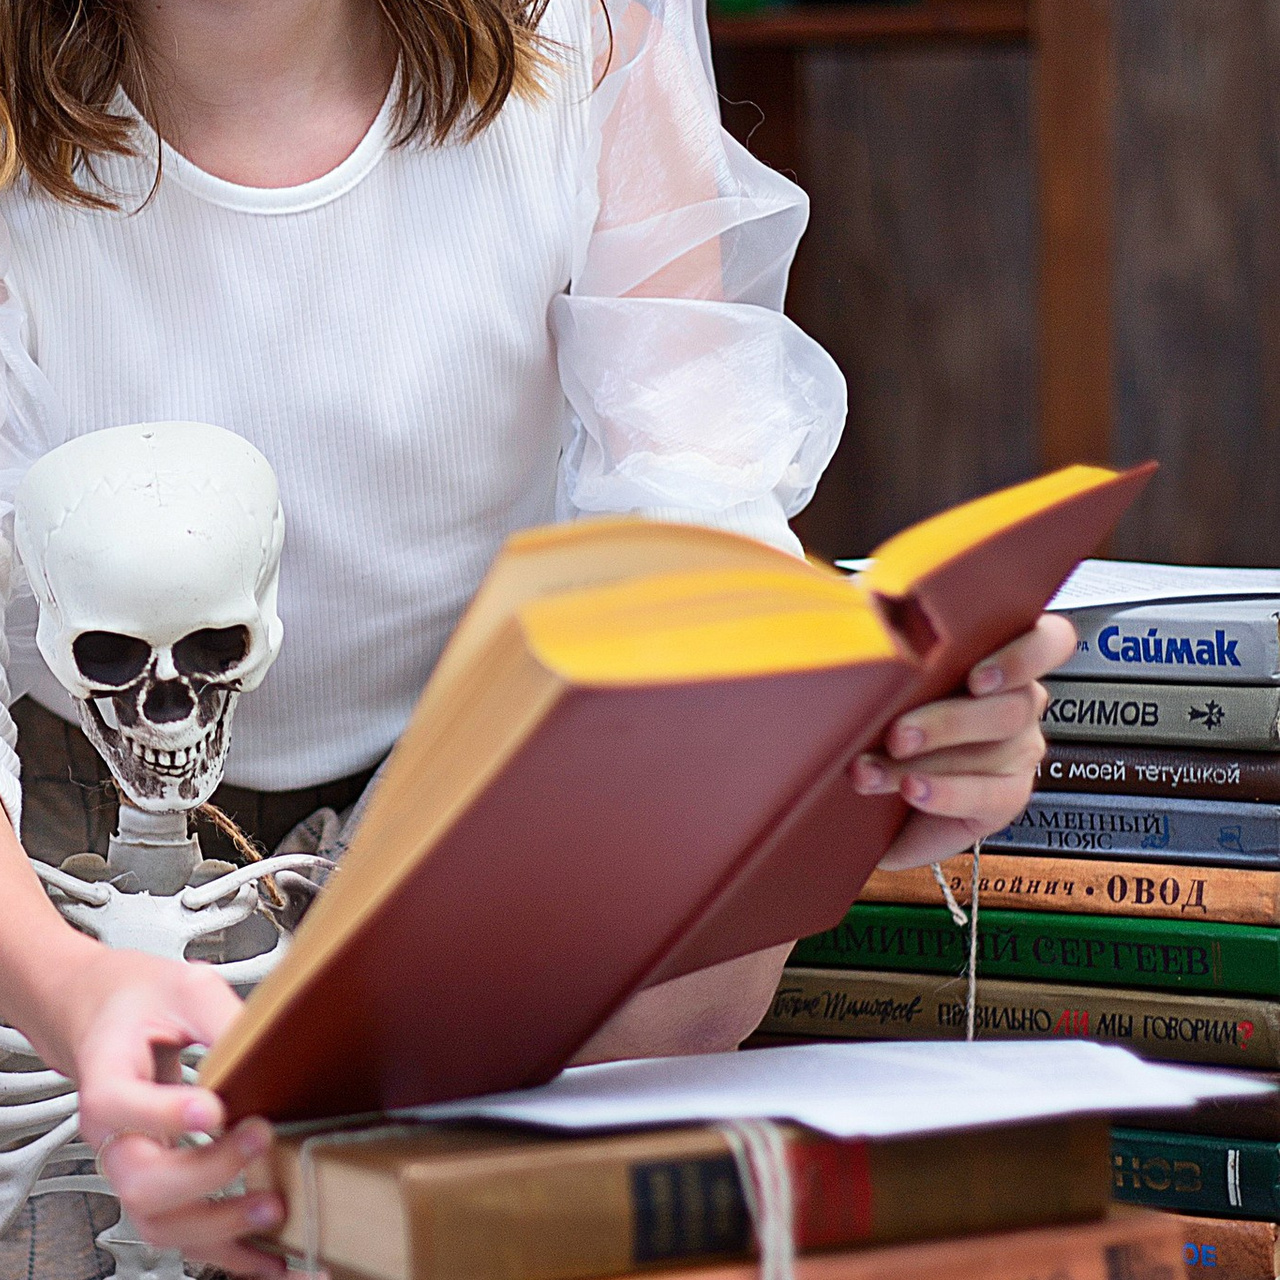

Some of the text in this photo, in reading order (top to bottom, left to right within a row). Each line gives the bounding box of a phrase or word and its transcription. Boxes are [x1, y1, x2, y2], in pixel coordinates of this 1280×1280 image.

[1097, 625, 1242, 667] Саймак
[1040, 699, 1159, 728] КСИМОВ
[1069, 760, 1126, 782] моей
[1010, 810, 1163, 835] АМЕННЫЙ
[1046, 831, 1113, 850] ПОЯС
[1106, 874, 1208, 915] ОВОД
[1032, 935, 1210, 976] СЕРГЕЕВ
[937, 1002, 1052, 1032] ПРАВИЛЬНО
[1052, 1008, 1089, 1037] ЛИ
[1096, 1012, 1133, 1039] МЫ
[1142, 1014, 1254, 1051] ГОВОРИМ?
